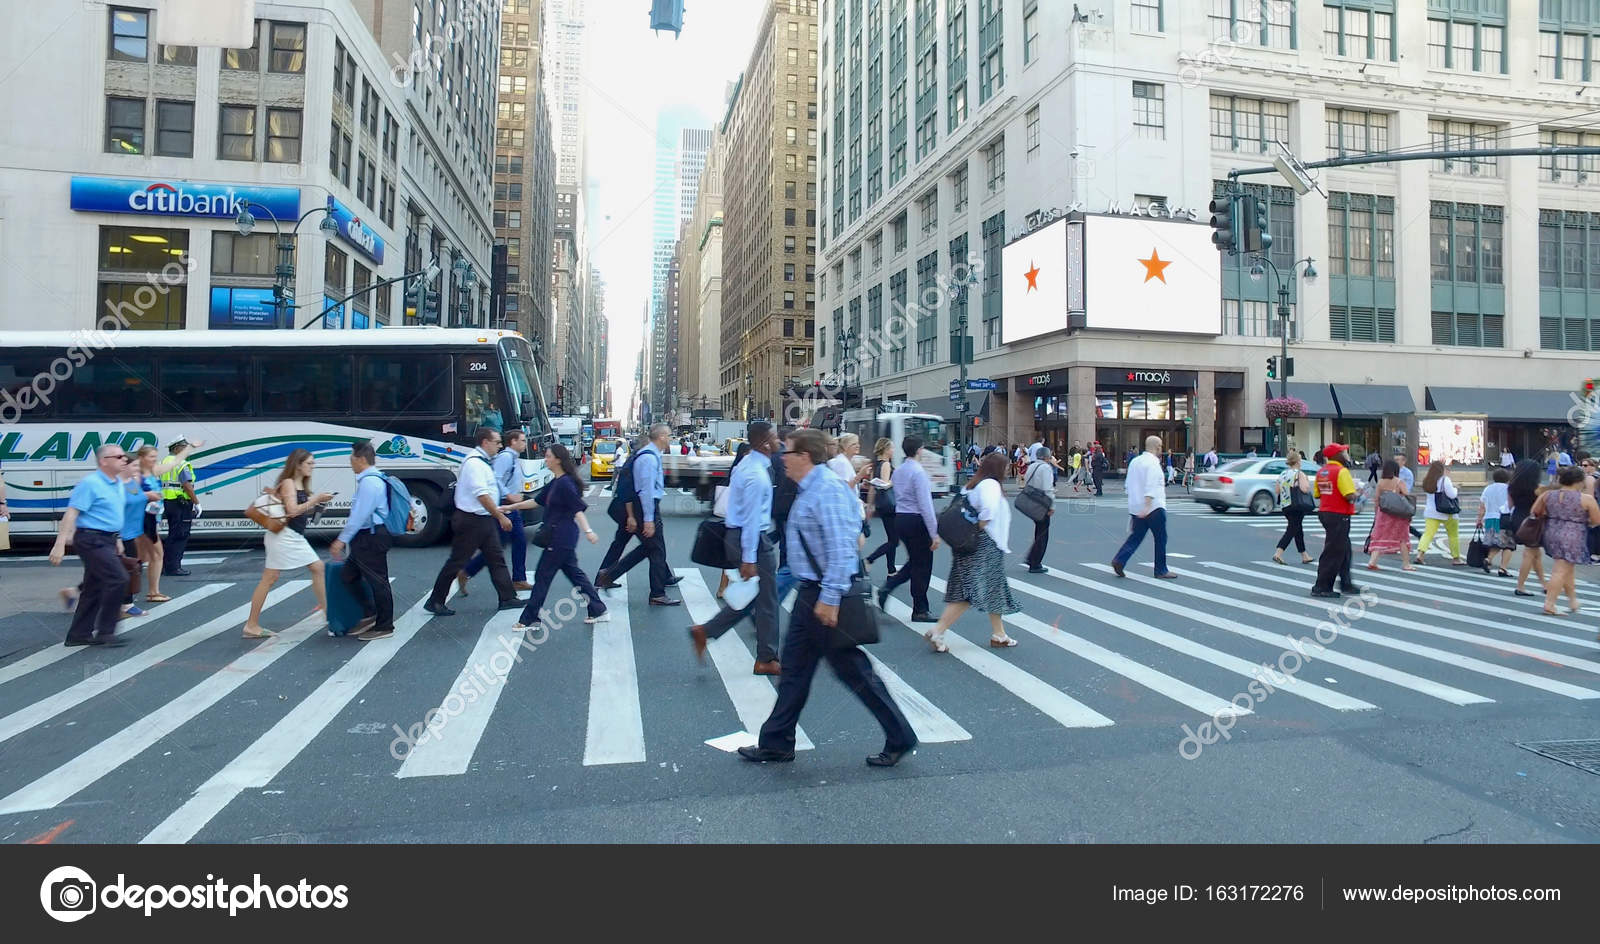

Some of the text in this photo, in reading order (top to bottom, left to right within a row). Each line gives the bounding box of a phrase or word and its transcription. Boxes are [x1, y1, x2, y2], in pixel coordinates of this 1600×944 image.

[128, 186, 244, 214] citibank
[470, 362, 487, 371] 204
[1135, 371, 1171, 384] macy's
